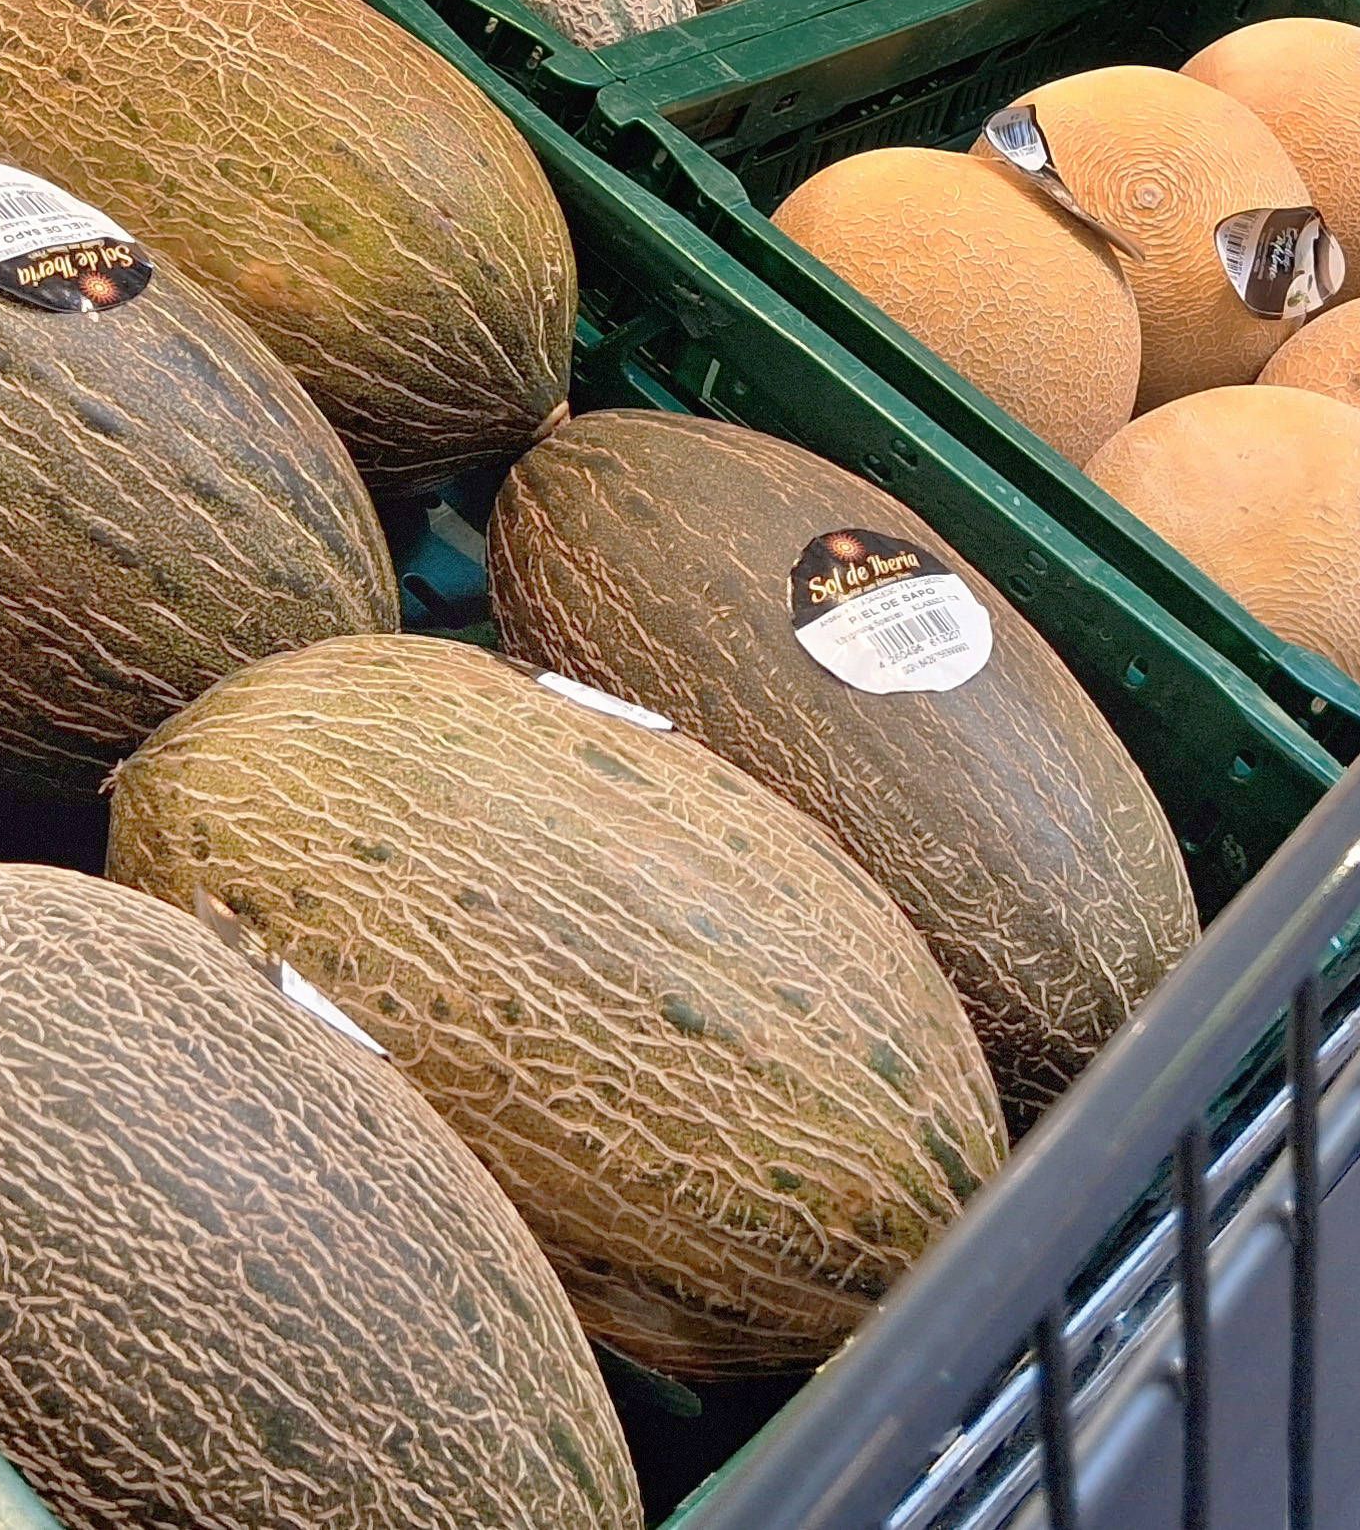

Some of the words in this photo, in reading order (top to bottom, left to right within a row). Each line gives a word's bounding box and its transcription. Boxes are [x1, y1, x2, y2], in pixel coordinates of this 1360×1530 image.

[76, 250, 98, 271] de
[101, 244, 134, 268] Sol
[17, 259, 79, 288] Iberia
[808, 570, 842, 604] Sol
[846, 562, 869, 586] de
[866, 551, 921, 576] Iberia
[881, 599, 900, 612] DE
[902, 587, 935, 603] SAPO
